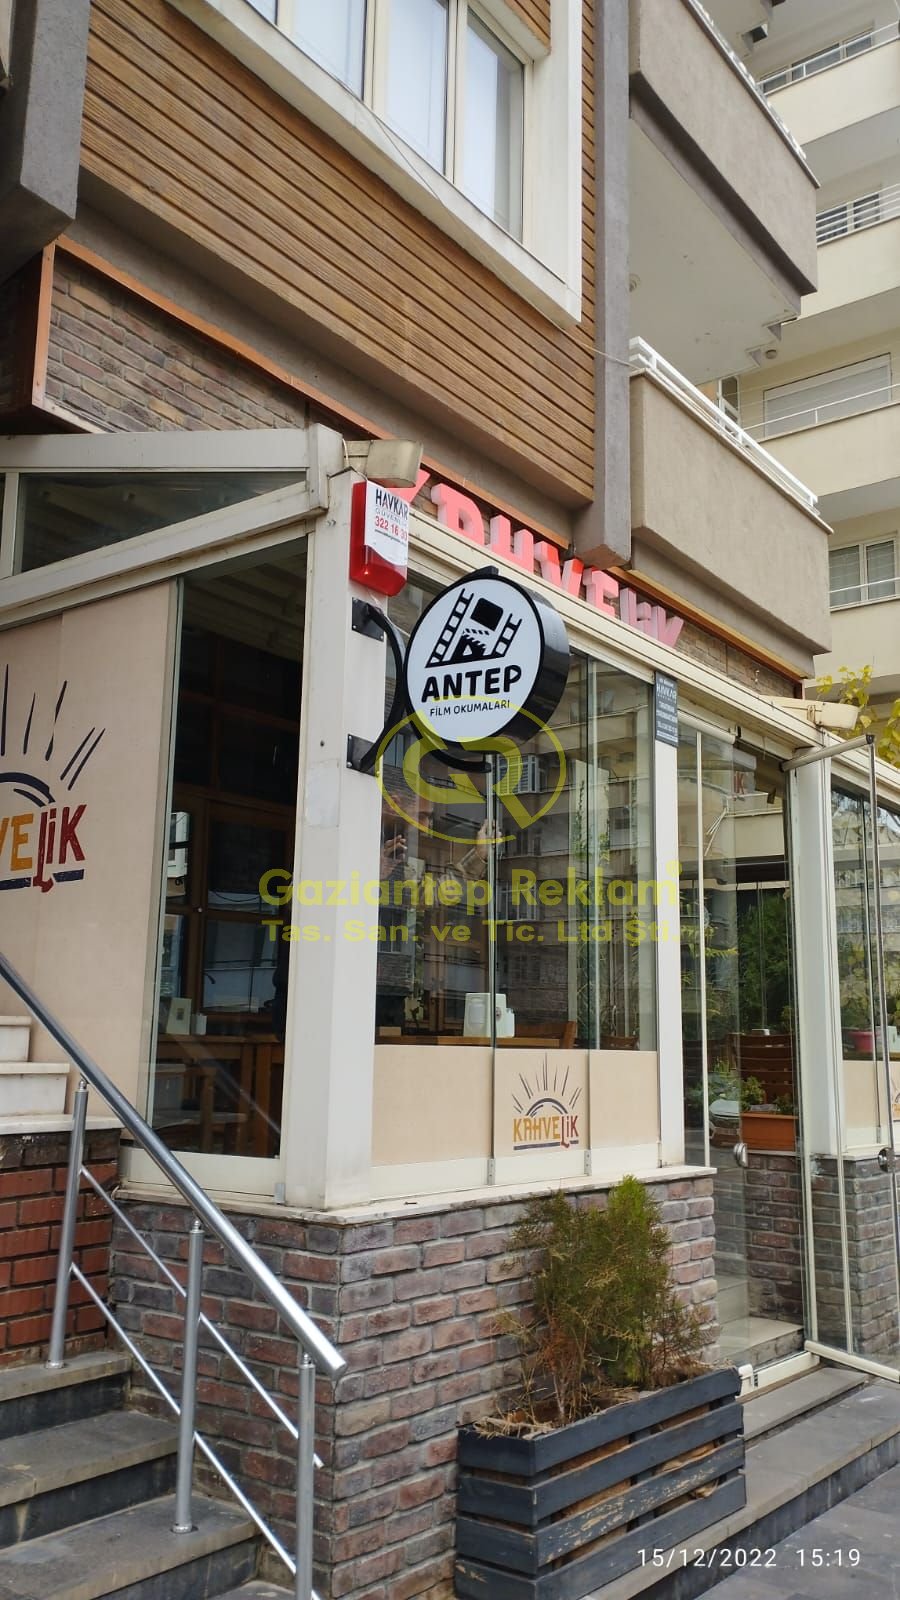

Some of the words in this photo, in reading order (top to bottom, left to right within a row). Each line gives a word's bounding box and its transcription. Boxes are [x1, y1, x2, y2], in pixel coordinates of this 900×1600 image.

[375, 488, 409, 521] HAVKAR
[374, 515, 389, 530] 322
[391, 524, 399, 536] 16
[421, 664, 522, 703] ANTEP
[430, 706, 451, 717] FİLM
[453, 699, 510, 714] OKUMALARI
